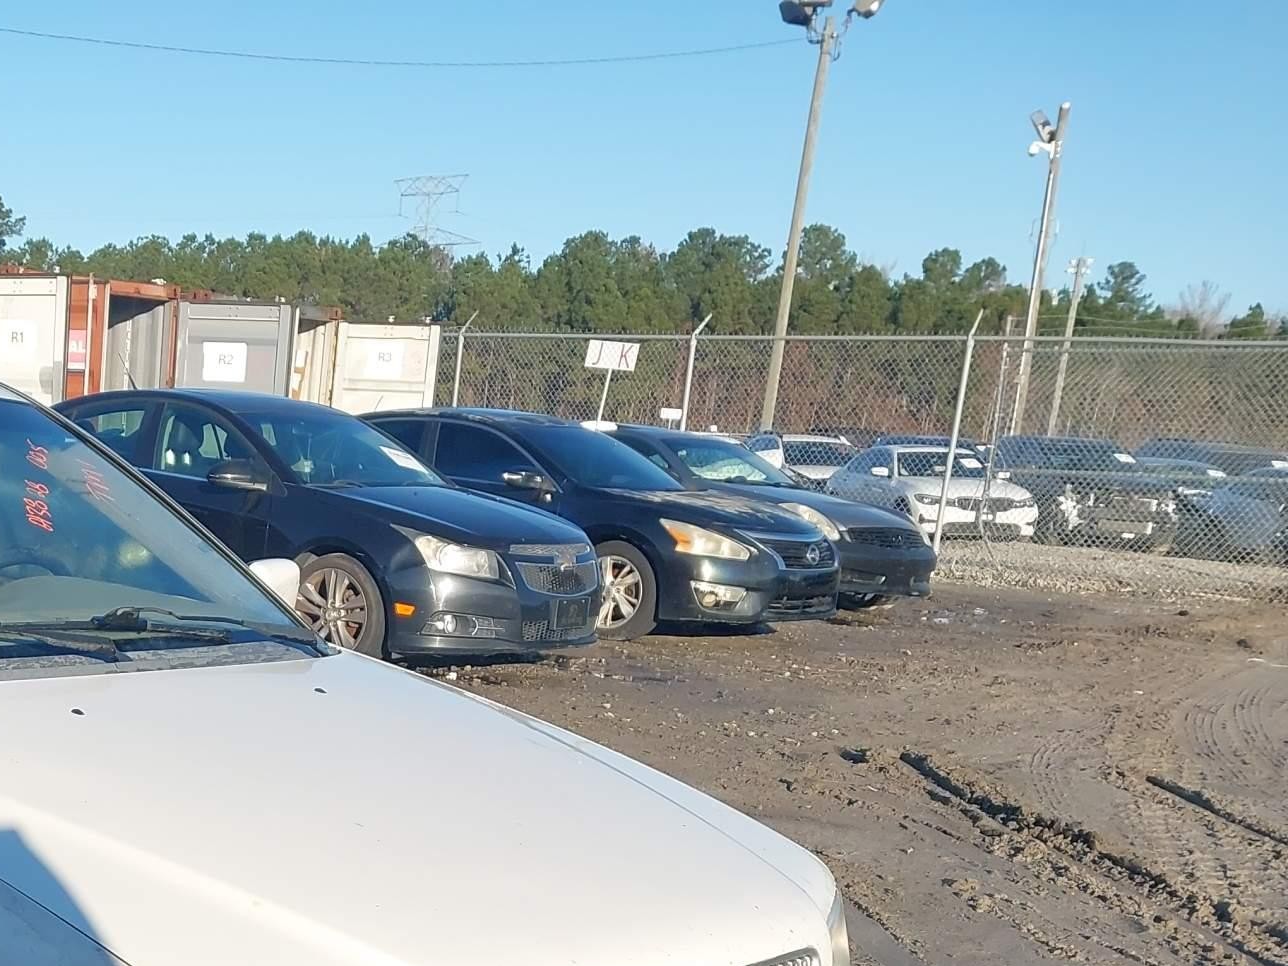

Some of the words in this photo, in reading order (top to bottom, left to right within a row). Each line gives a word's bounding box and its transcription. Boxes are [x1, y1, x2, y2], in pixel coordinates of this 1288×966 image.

[10, 331, 25, 344] R1
[218, 353, 234, 366] R2
[591, 341, 604, 366] J
[617, 343, 634, 369] K
